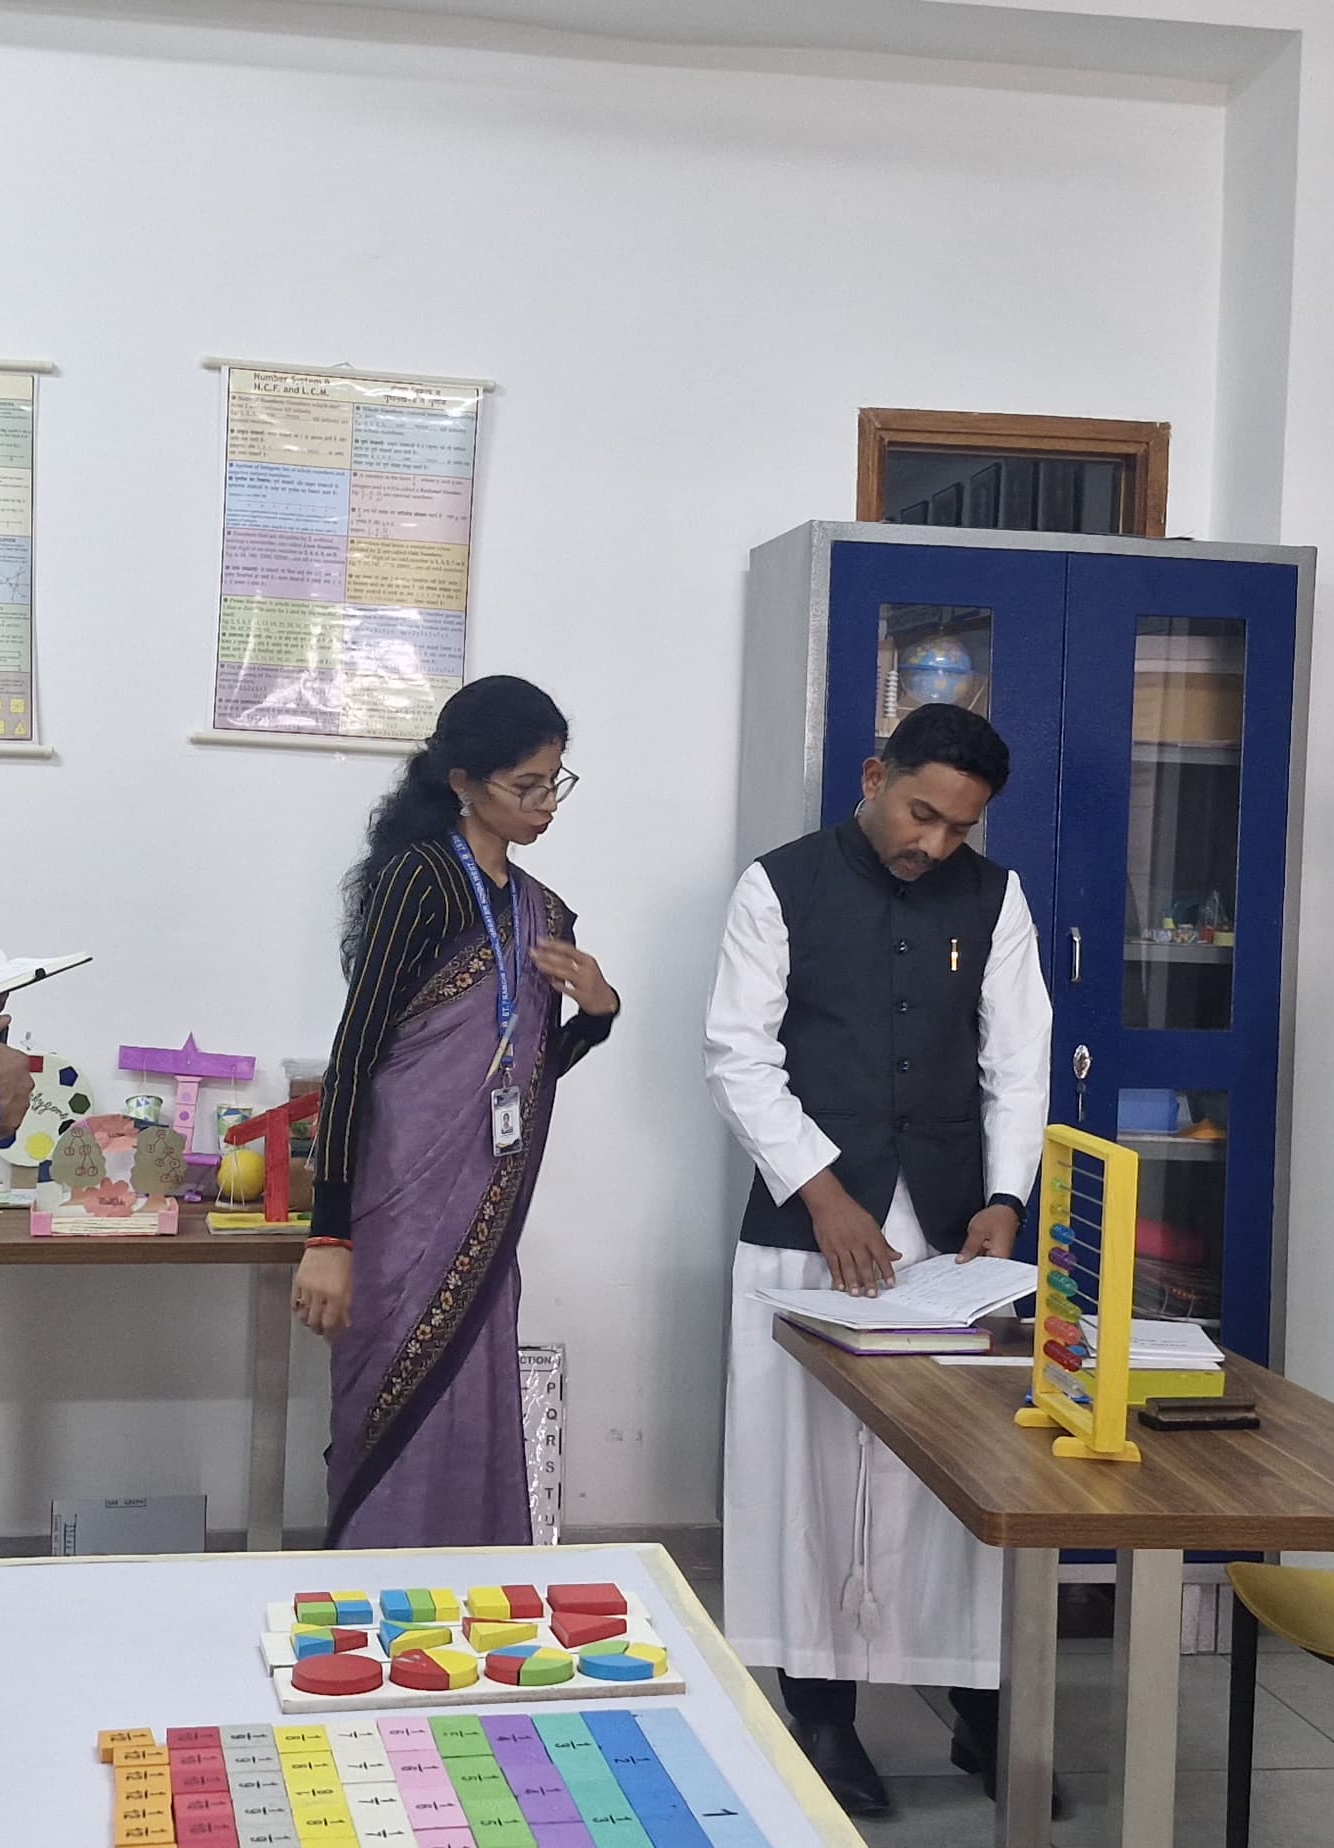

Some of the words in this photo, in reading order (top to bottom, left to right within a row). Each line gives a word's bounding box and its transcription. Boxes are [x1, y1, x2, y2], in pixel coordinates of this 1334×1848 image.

[253, 372, 288, 382] Number
[283, 384, 300, 395] and
[546, 1382, 556, 1394] P
[546, 1409, 558, 1420] Q
[546, 1434, 556, 1446] R
[546, 1461, 555, 1473] S
[544, 1488, 555, 1499] T
